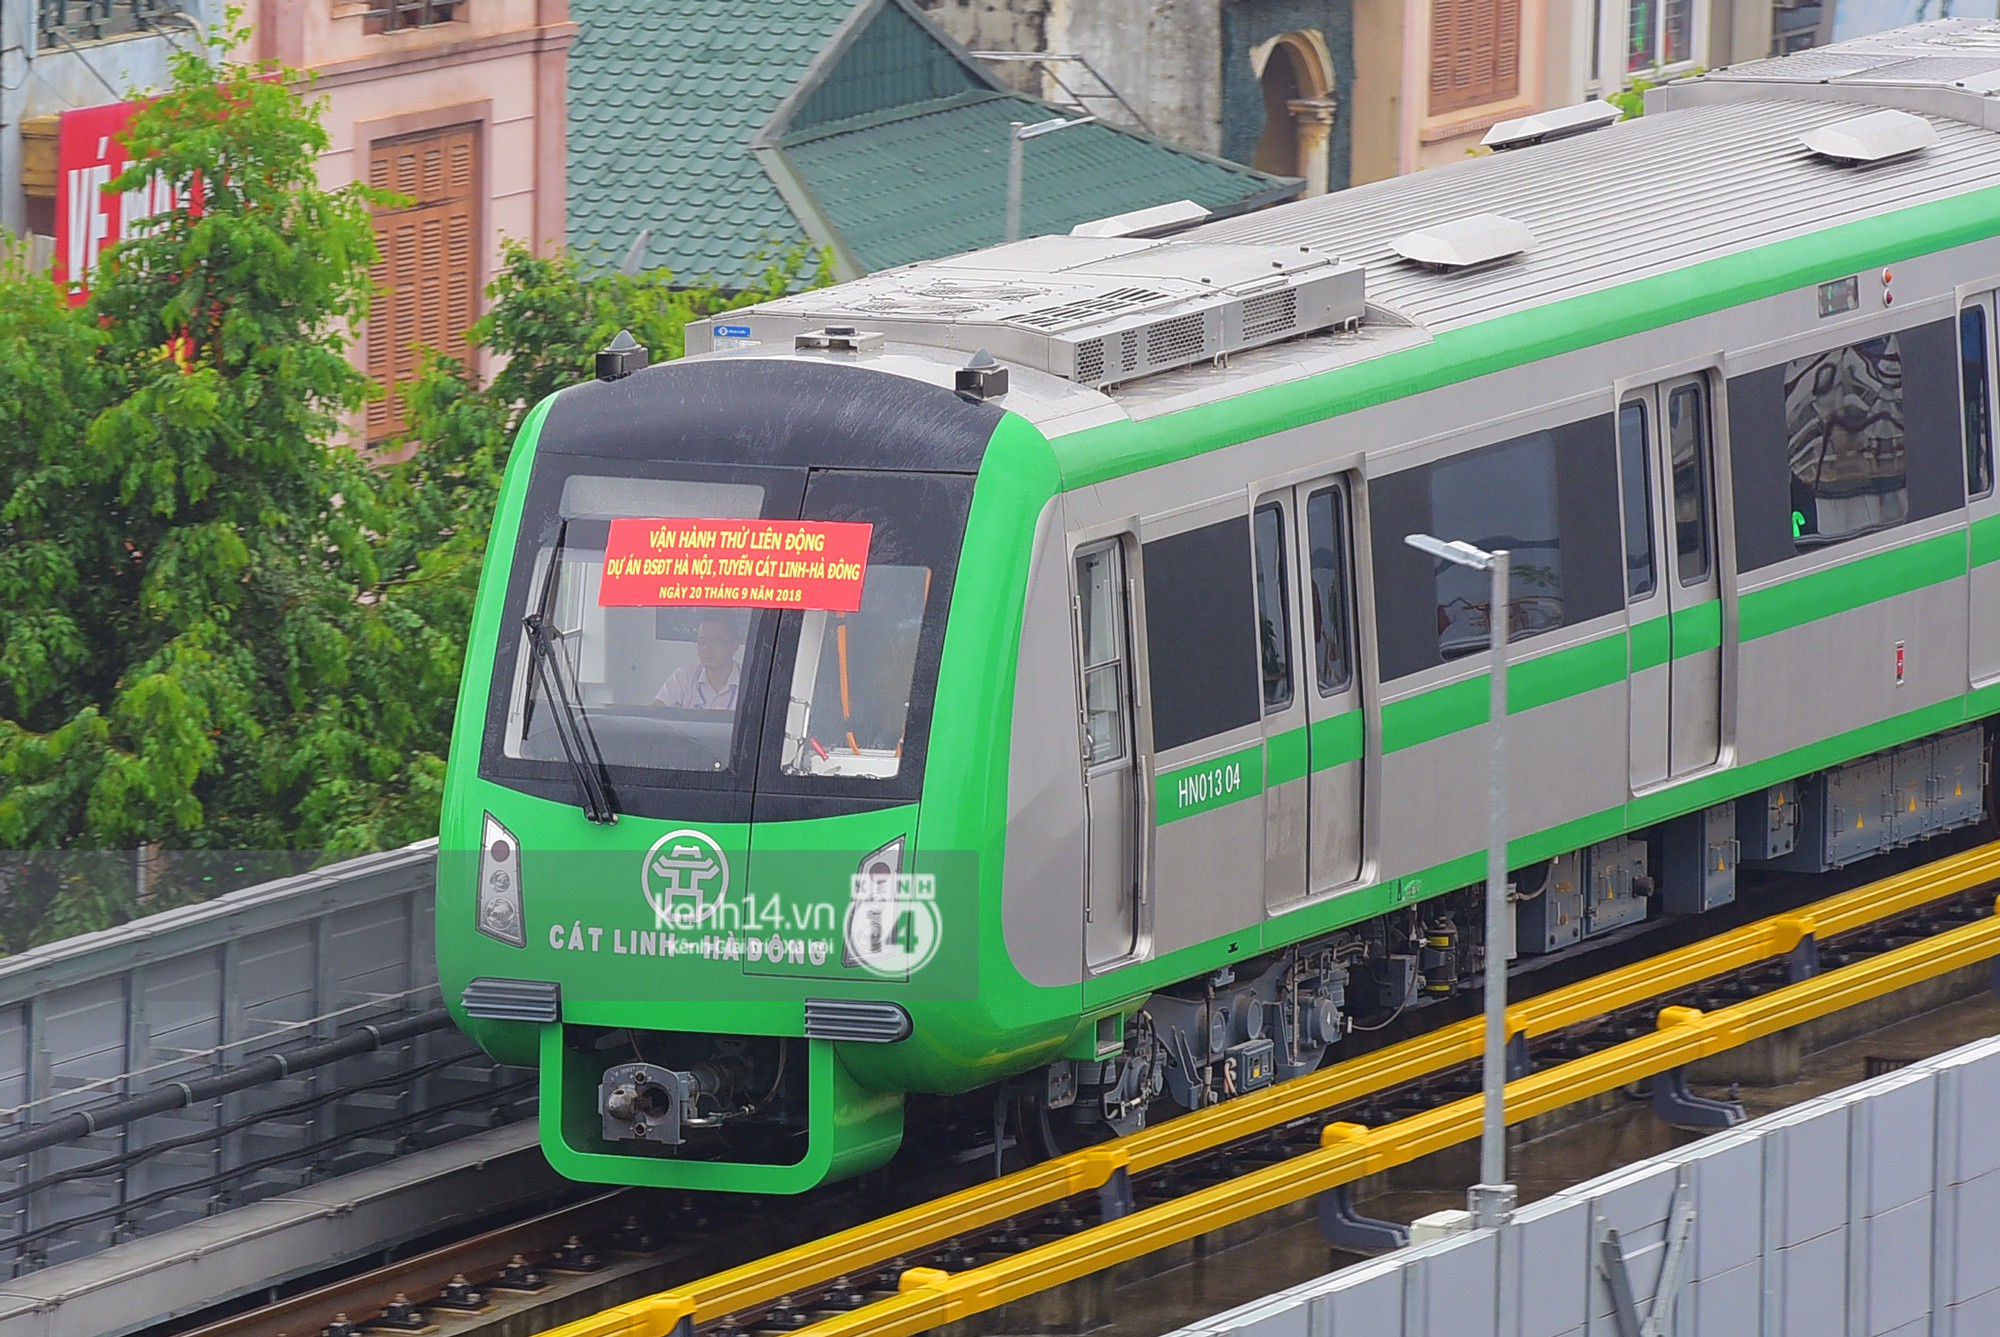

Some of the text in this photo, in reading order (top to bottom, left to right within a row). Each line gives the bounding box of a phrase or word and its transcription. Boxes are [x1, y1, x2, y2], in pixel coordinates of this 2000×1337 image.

[649, 524, 825, 555] VẬN HÀNH THỬ LIÊN ĐỘNG
[607, 556, 626, 580] DỰ
[624, 553, 642, 576] ÁN
[643, 558, 673, 576] ĐSĐT
[673, 553, 689, 576] HÀ
[718, 554, 754, 577] TUYẾN
[755, 555, 778, 577] CÁT
[779, 556, 825, 579] LINH-HÀ
[827, 557, 861, 581] ĐÔNG
[659, 583, 802, 602] NGÀY 20 THÁNG 9 NĂM 2018
[1225, 762, 1241, 793] 04
[549, 920, 603, 952] CÁT
[613, 928, 676, 957] LINH
[703, 930, 740, 961] HÀ
